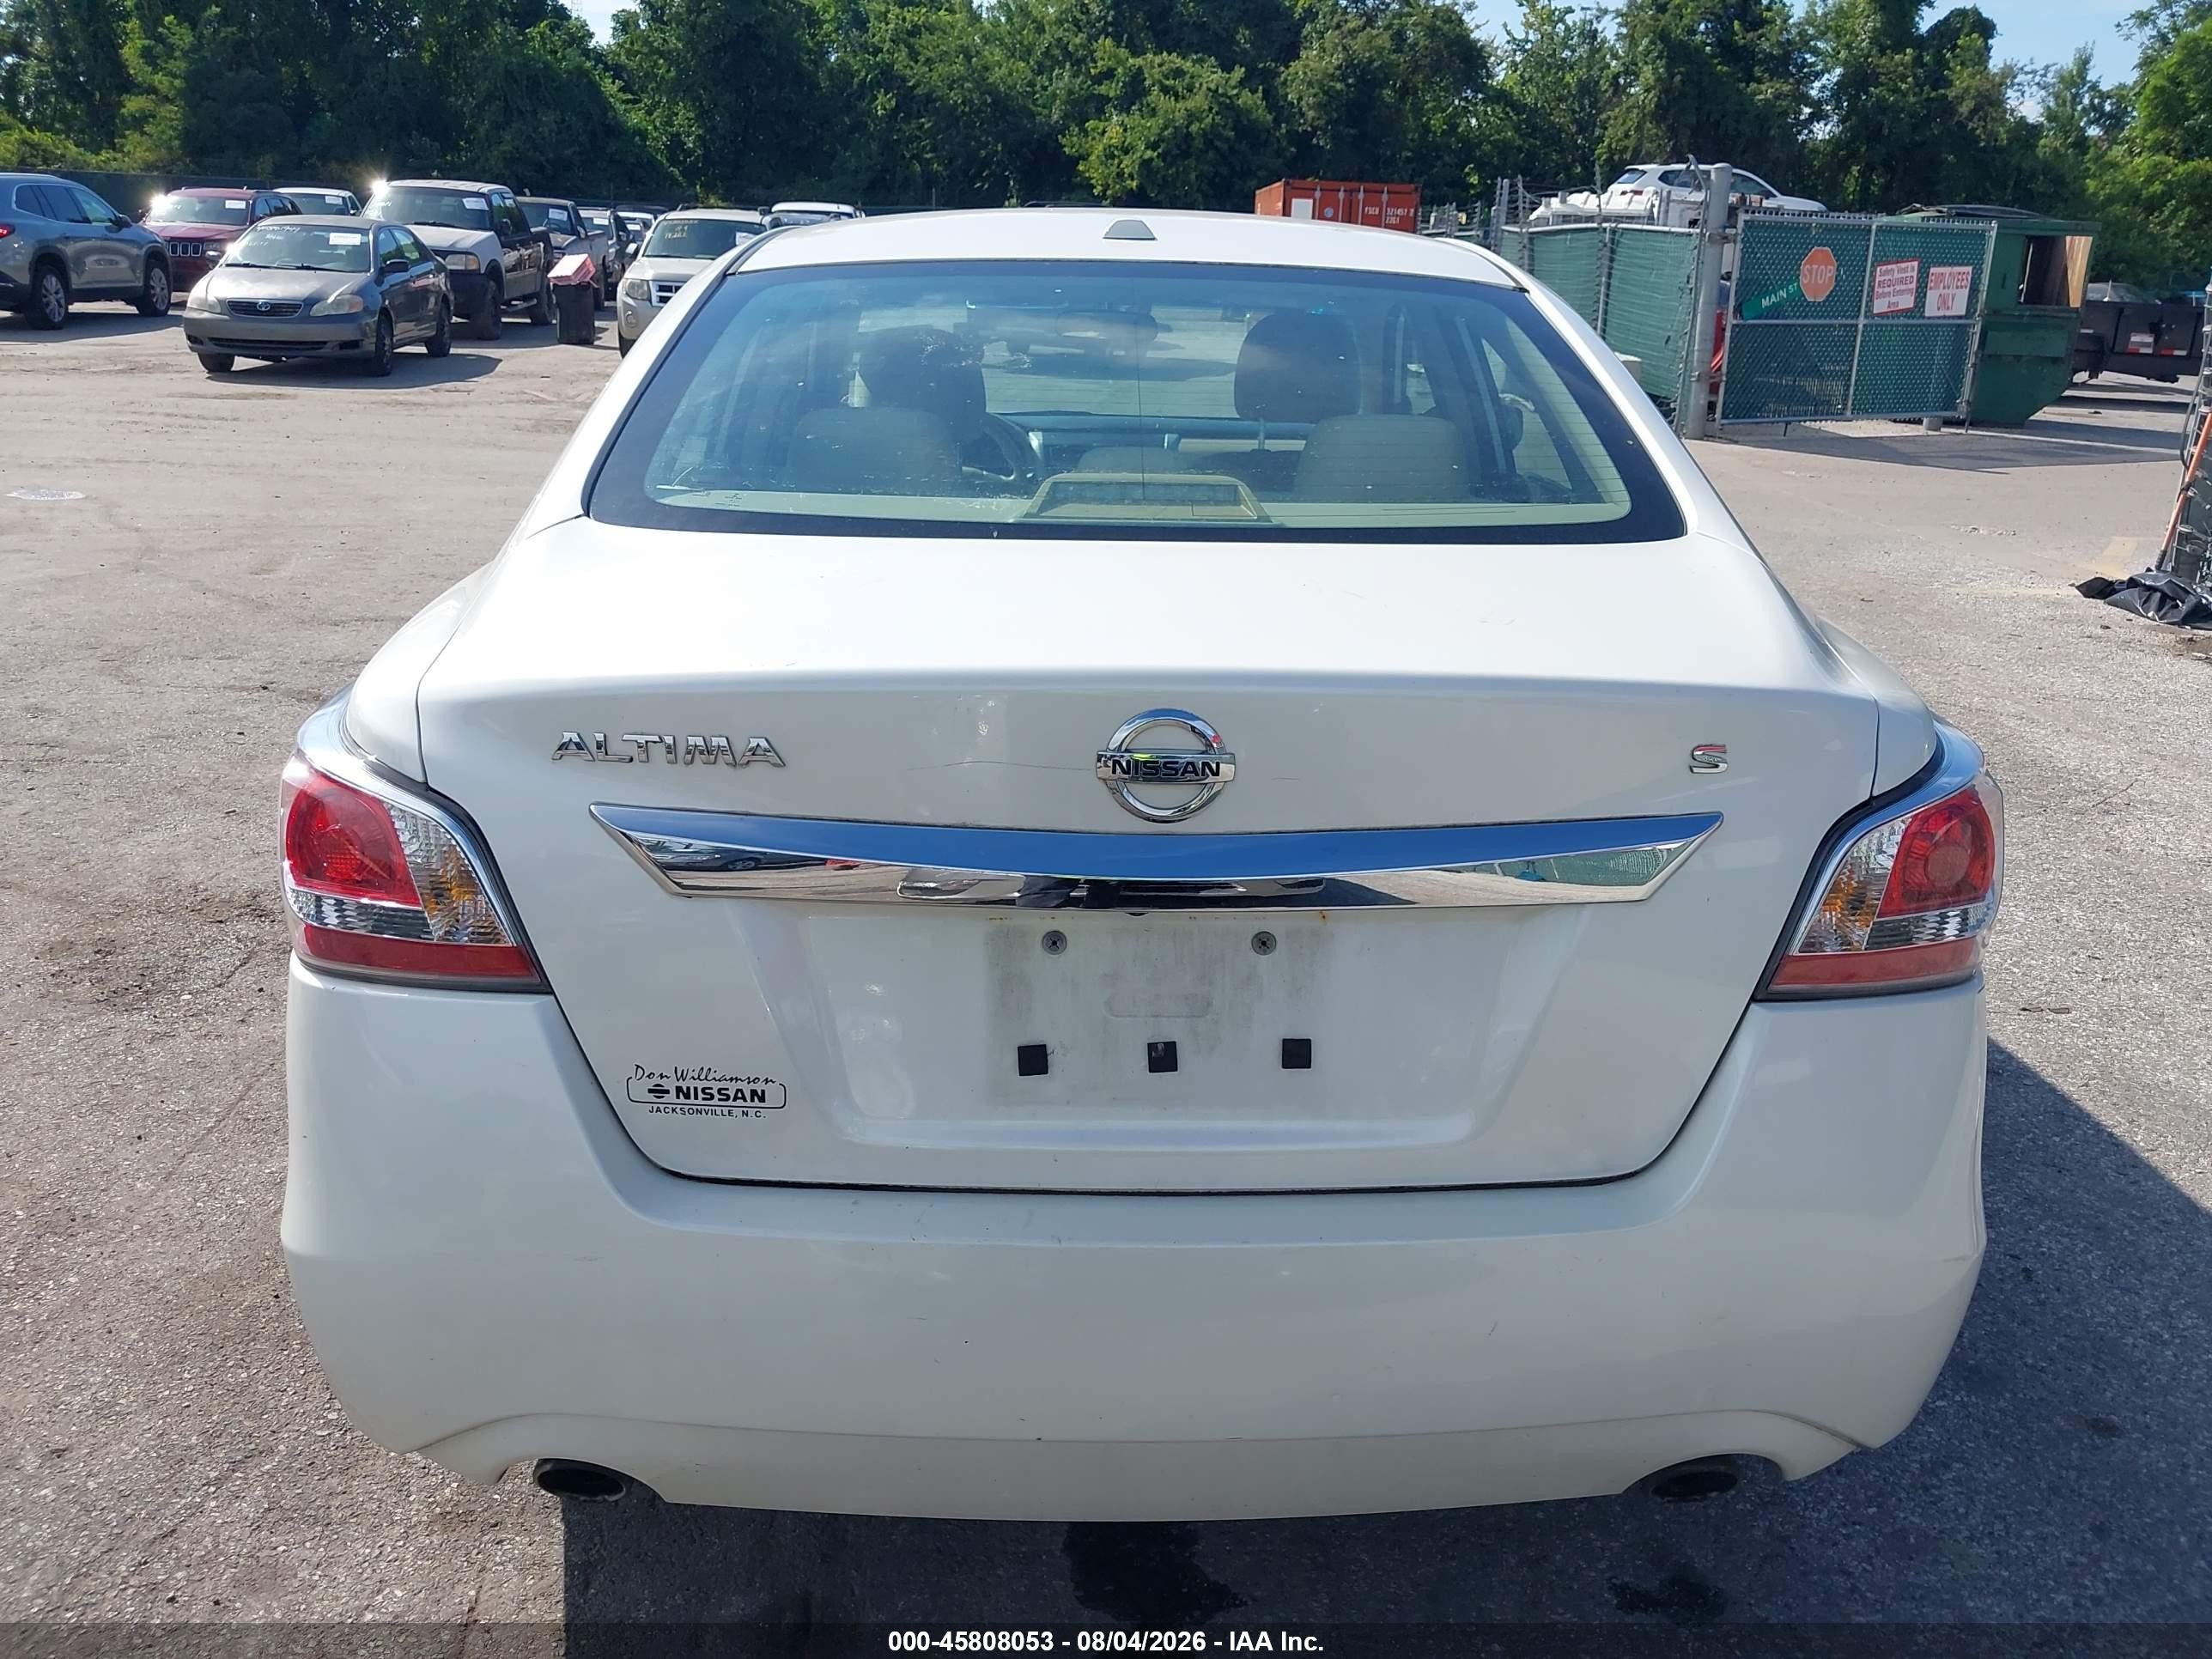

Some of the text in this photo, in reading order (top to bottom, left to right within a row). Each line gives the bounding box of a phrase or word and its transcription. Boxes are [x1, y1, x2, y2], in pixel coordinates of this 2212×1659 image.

[1803, 264, 1834, 284] STOP
[1877, 275, 1914, 289] REQUIRED
[1929, 270, 1970, 290] EMPLOYEES
[1761, 283, 1798, 308] MAIN ST
[1936, 293, 1956, 312] ONLY
[551, 732, 786, 768] ALTIMA
[1689, 744, 1728, 774] S
[1111, 758, 1221, 778] NISSAN
[634, 1064, 776, 1085] Don Williamson
[675, 1085, 766, 1103] NISSAN
[648, 1105, 767, 1119] JACKSONVILLE, N.C.
